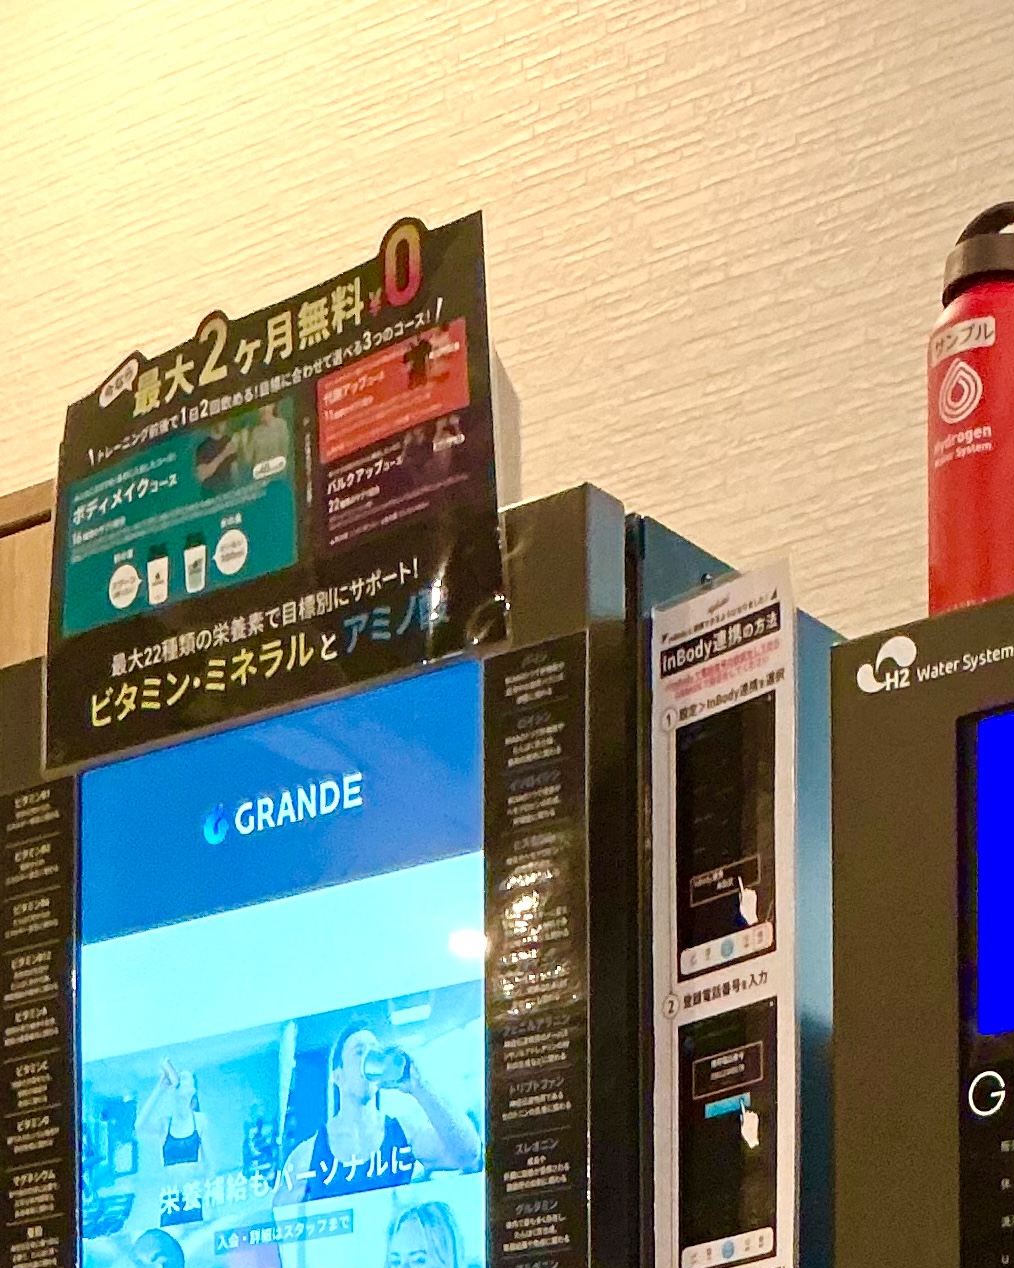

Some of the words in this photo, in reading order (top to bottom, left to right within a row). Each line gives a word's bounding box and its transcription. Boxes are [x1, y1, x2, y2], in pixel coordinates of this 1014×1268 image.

[368, 227, 422, 318] ¥0
[934, 425, 992, 453] Hydrogen
[956, 442, 992, 457] System
[73, 473, 178, 526] ボディメイクコース
[111, 557, 419, 677] 最大22種類の栄養素で目標別にサポート!
[662, 611, 779, 673] InBody連携の方法
[885, 670, 911, 692] H2
[916, 659, 962, 683] Water
[962, 645, 1014, 673] System
[234, 771, 364, 836] GRANDE
[668, 1001, 675, 1014] 2
[508, 1077, 565, 1095] トリプトファン
[159, 1145, 414, 1216] 栄養補給もパーソナルに
